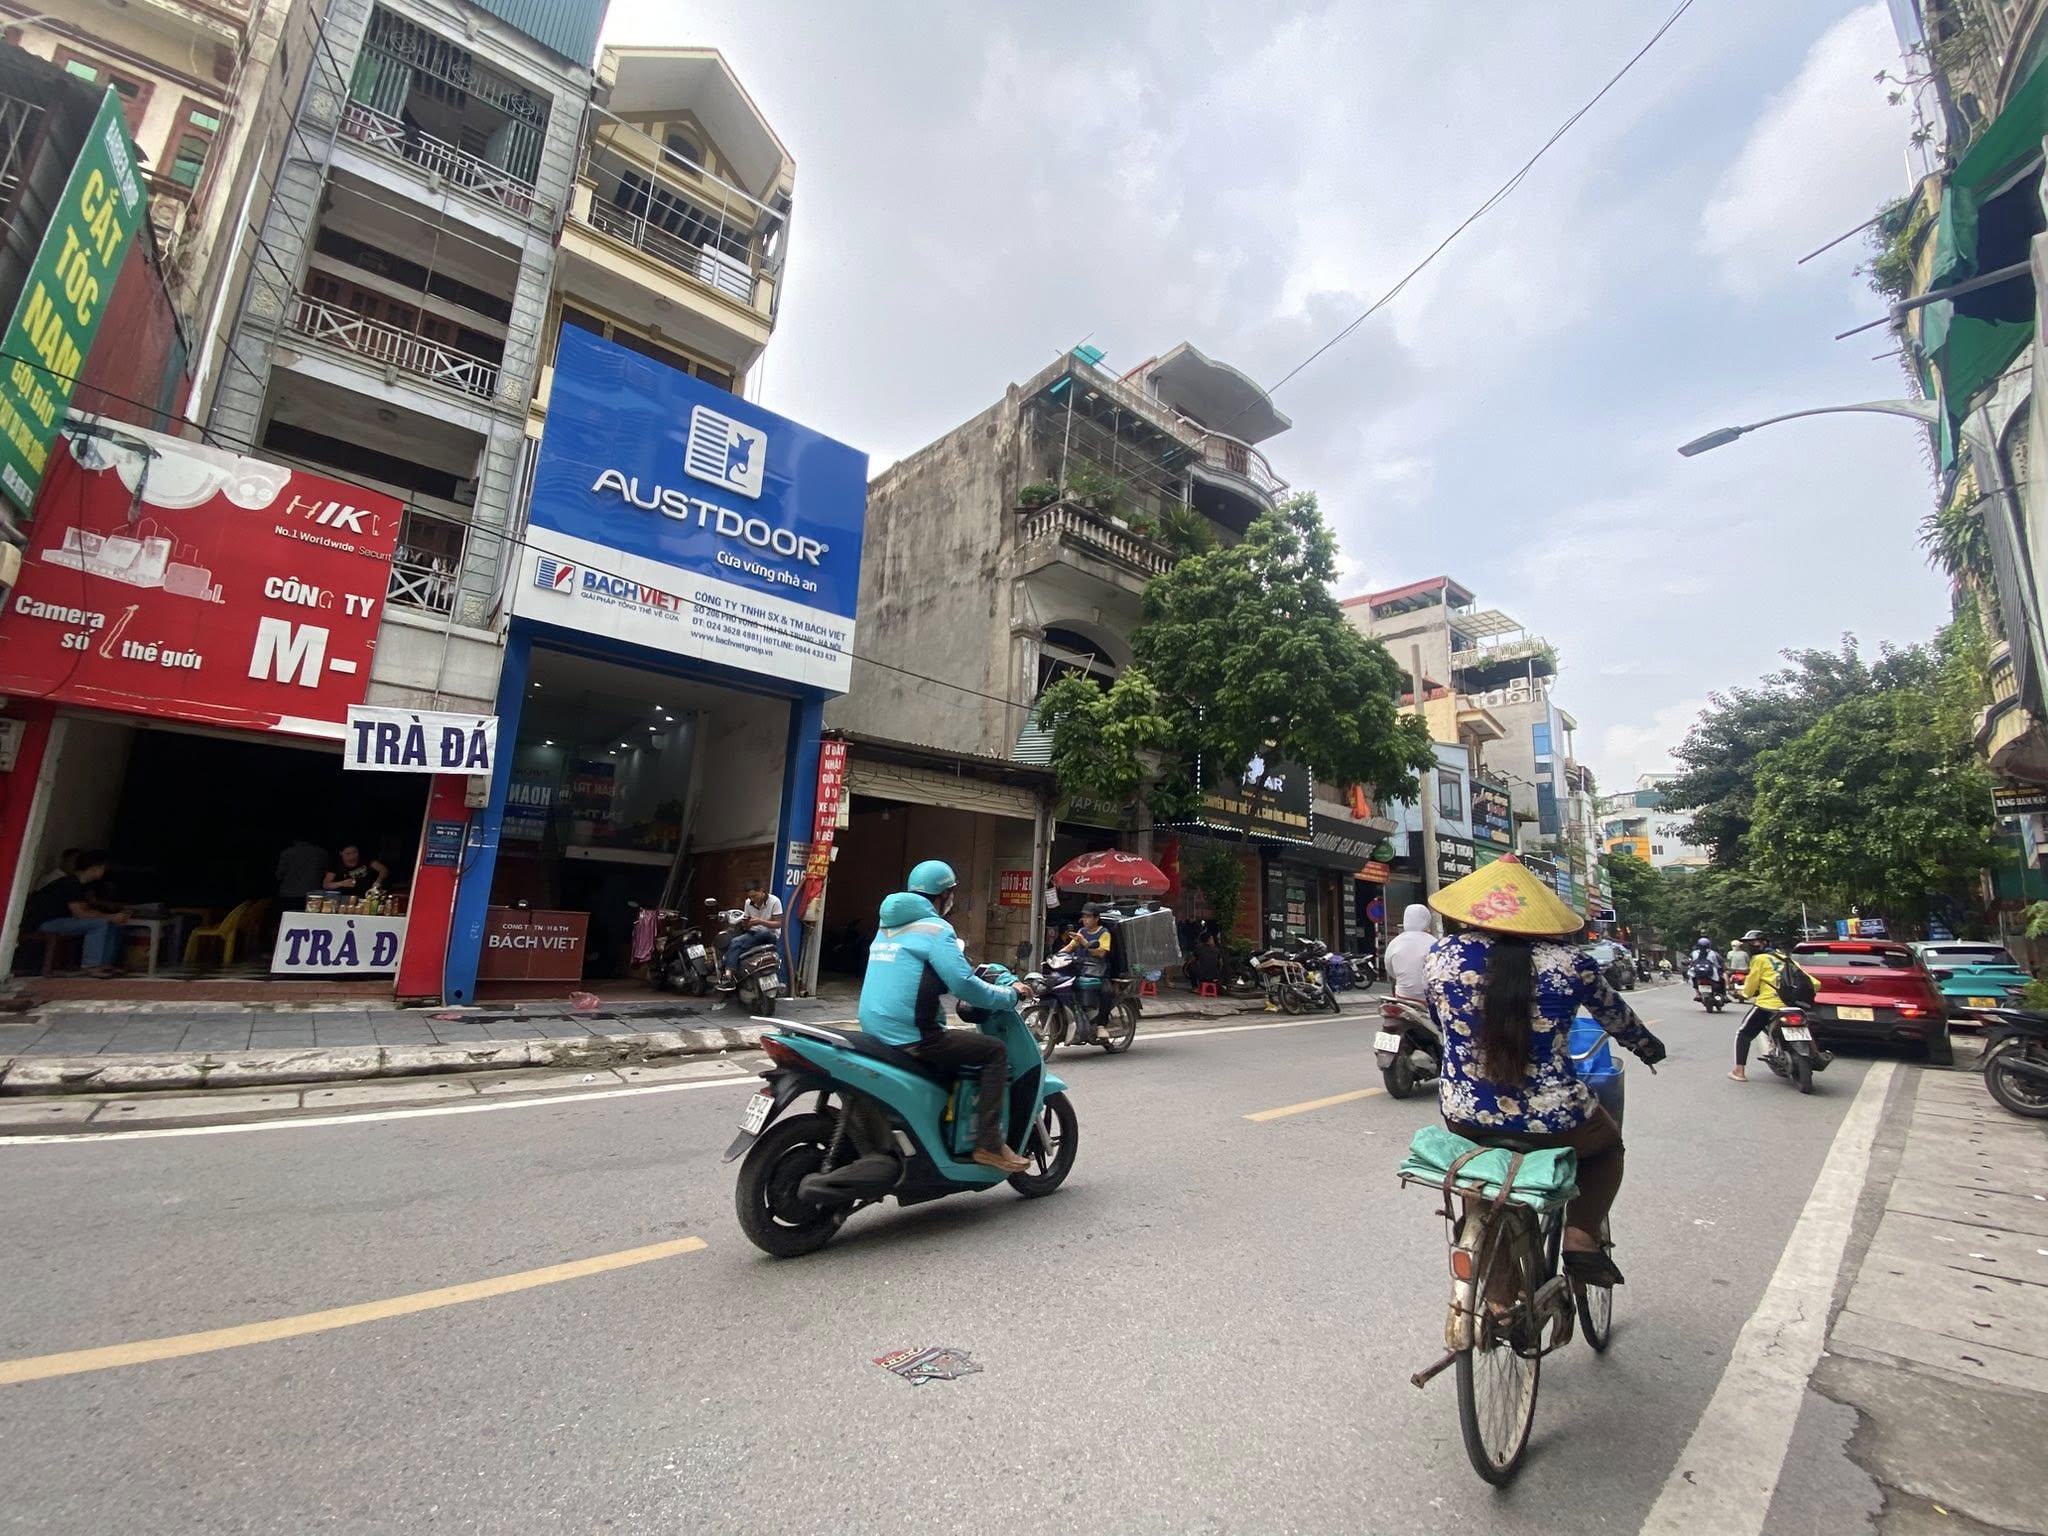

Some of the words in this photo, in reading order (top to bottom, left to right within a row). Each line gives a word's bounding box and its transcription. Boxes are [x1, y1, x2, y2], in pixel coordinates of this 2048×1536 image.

[81, 168, 123, 268] CẮT
[55, 224, 98, 326] TÓC
[22, 280, 81, 397] NAM
[275, 525, 298, 539] No.1
[300, 531, 355, 552] Worldwide
[591, 469, 820, 566] AUSTDOOR
[717, 550, 741, 568] Cửa
[777, 571, 800, 587] nhà
[802, 579, 818, 592] an
[15, 595, 105, 629] Camera
[345, 593, 375, 618] TY
[725, 599, 738, 610] TY
[741, 604, 766, 619] TNHH
[768, 612, 779, 622] SX
[781, 616, 787, 625] &
[790, 618, 803, 630] TM
[61, 629, 96, 651] số
[121, 640, 164, 662] thế
[706, 620, 721, 631] 024
[812, 649, 824, 659] 433
[353, 715, 427, 766] TRÀ
[440, 721, 489, 768] ĐÁ
[285, 920, 359, 966] TRÀ
[370, 931, 398, 967] Đ
